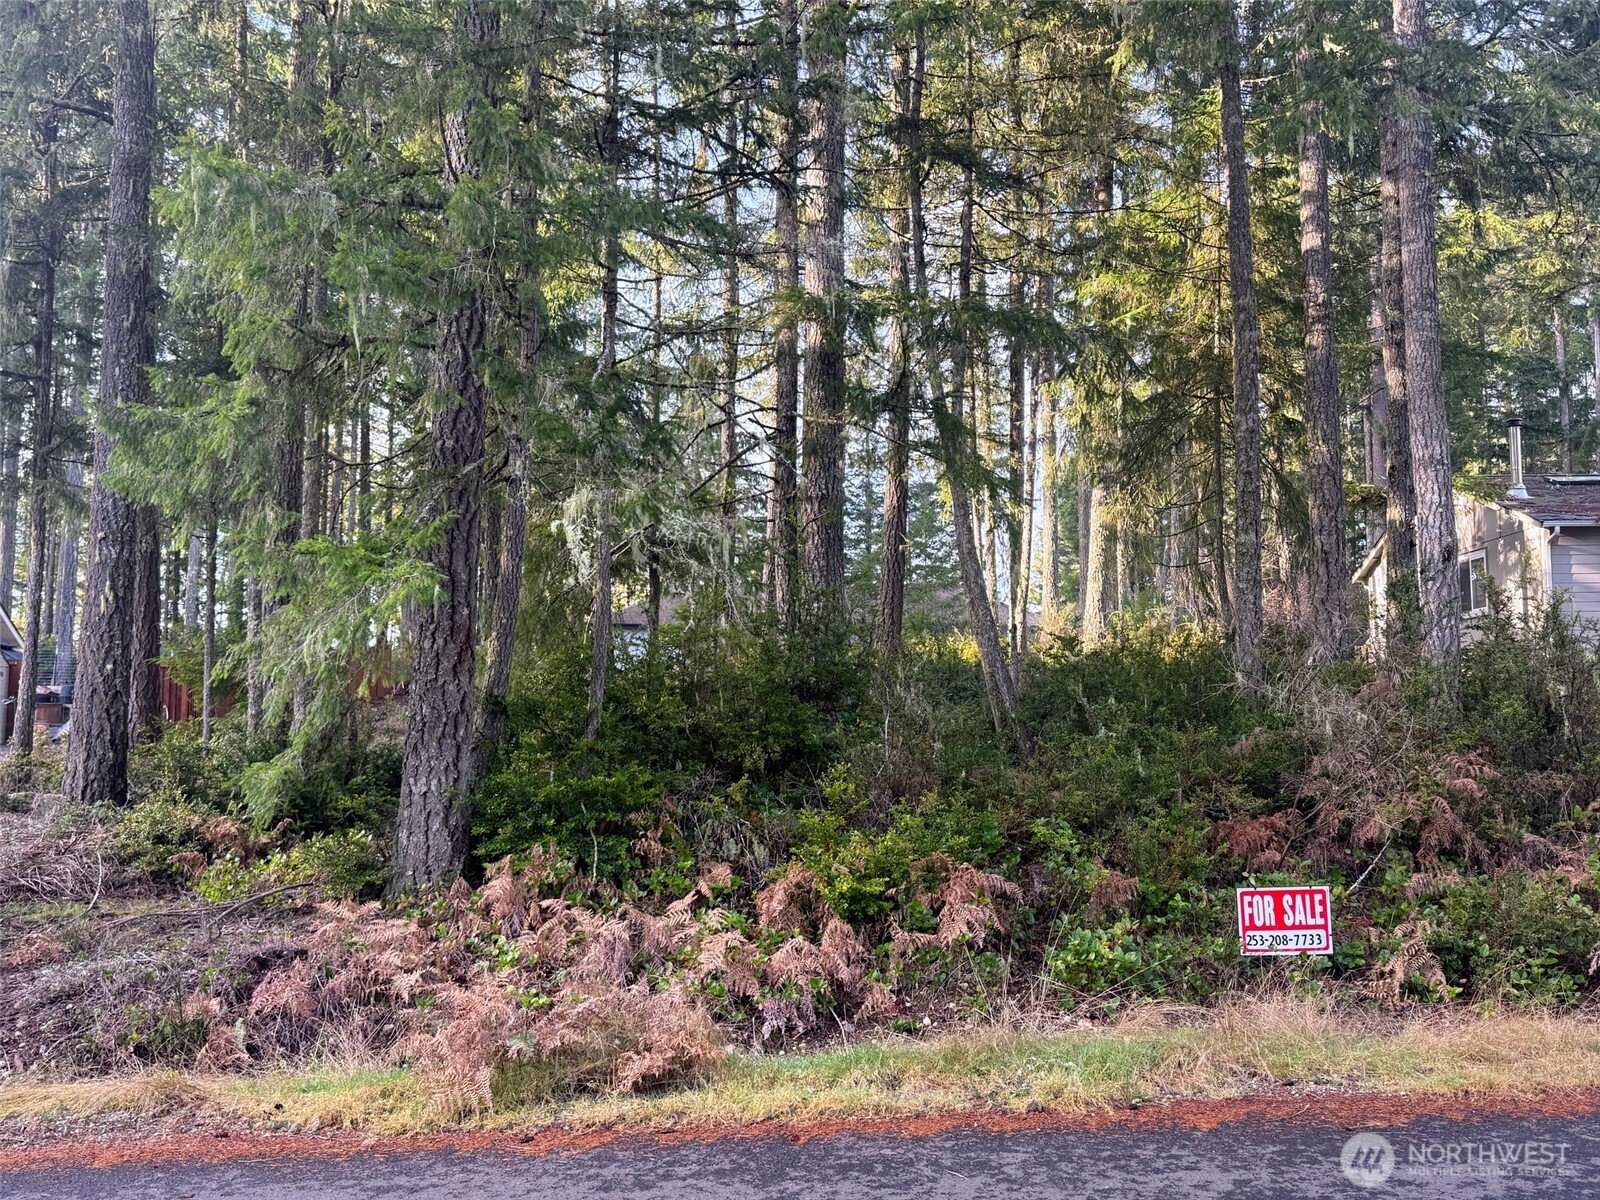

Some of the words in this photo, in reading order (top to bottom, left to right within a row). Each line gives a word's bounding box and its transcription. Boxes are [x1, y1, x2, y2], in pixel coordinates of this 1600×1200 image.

[1243, 894, 1276, 927] FOR
[1282, 893, 1325, 927] SALE
[1246, 934, 1322, 947] 253-208-7733
